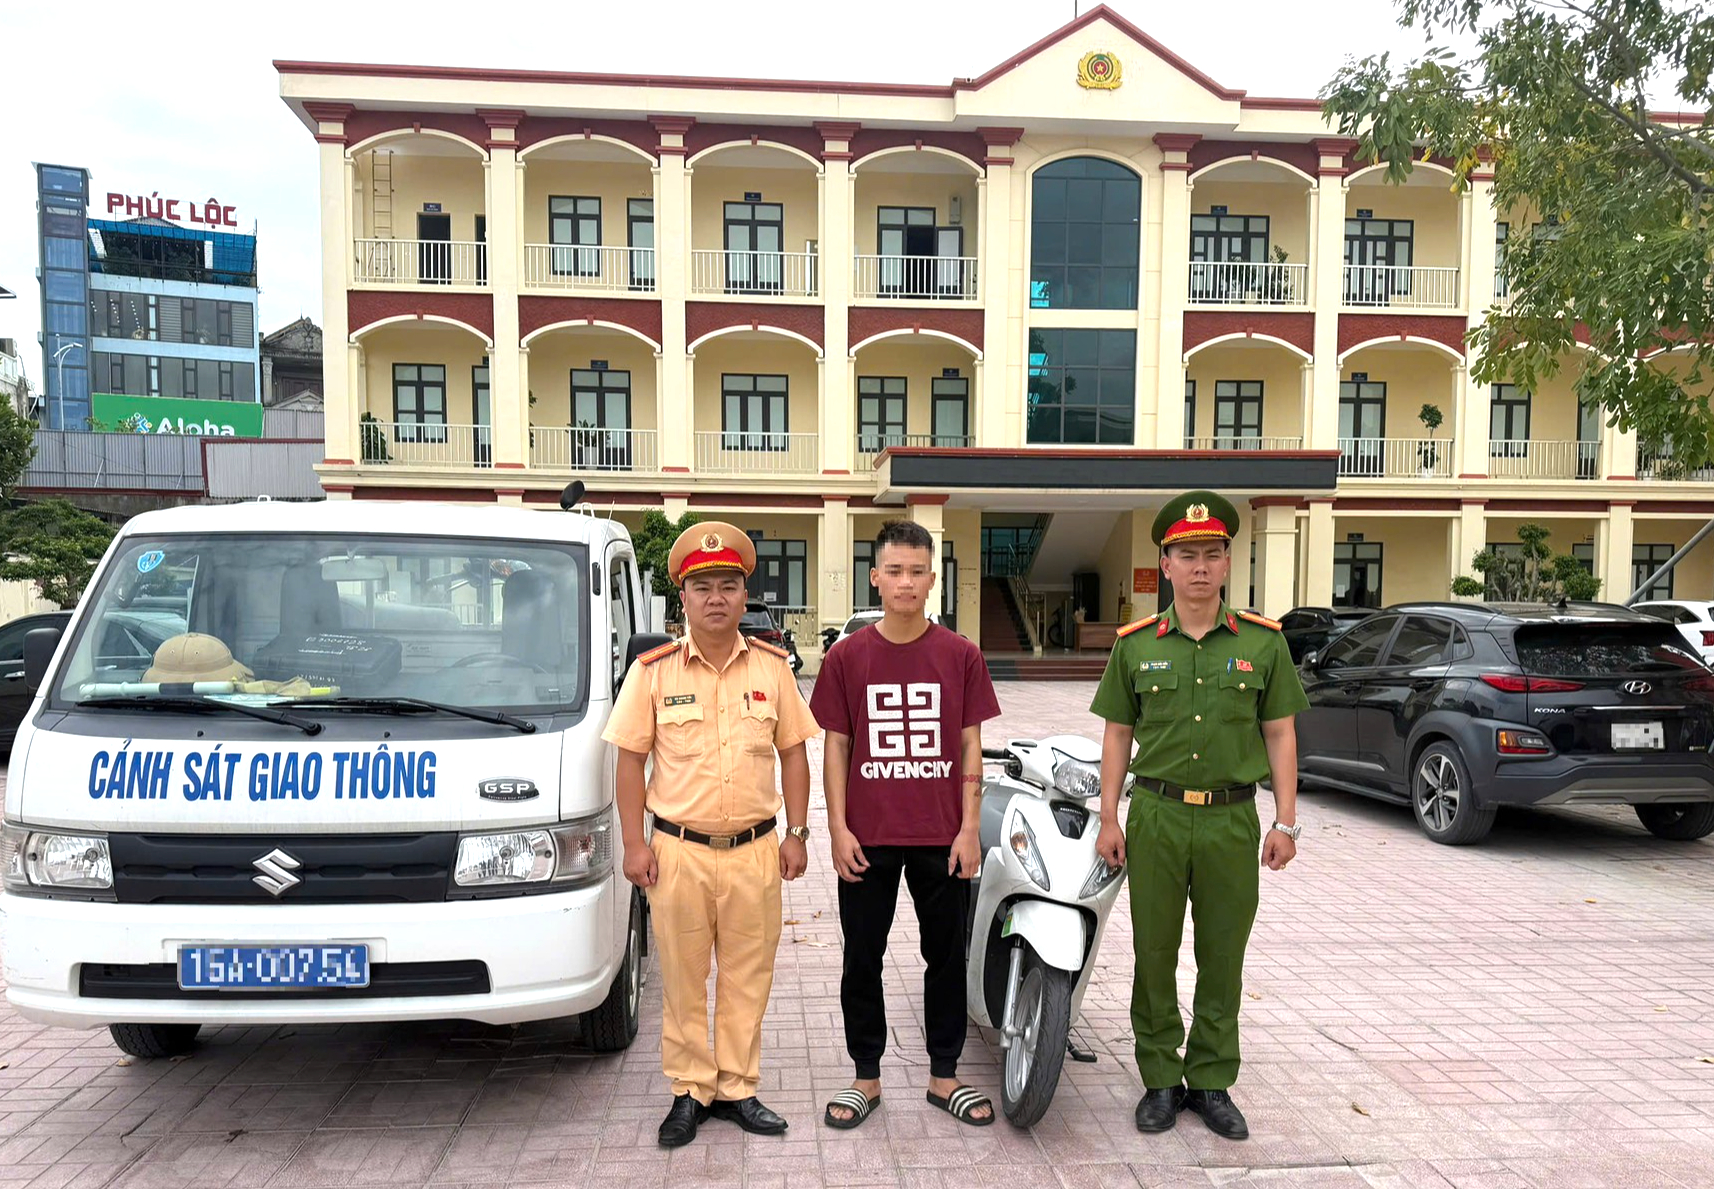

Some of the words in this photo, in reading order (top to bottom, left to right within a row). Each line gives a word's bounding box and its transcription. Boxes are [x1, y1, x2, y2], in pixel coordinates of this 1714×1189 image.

[107, 191, 181, 221] PHÚC
[190, 197, 238, 229] LỘC
[156, 417, 235, 436] Aloha
[88, 738, 174, 799] CẢNH
[183, 743, 242, 801] SÁT
[248, 752, 322, 801] GIAO
[333, 743, 437, 800] THÔNG
[860, 761, 953, 779] GIVENCHY
[484, 783, 530, 795] GSP
